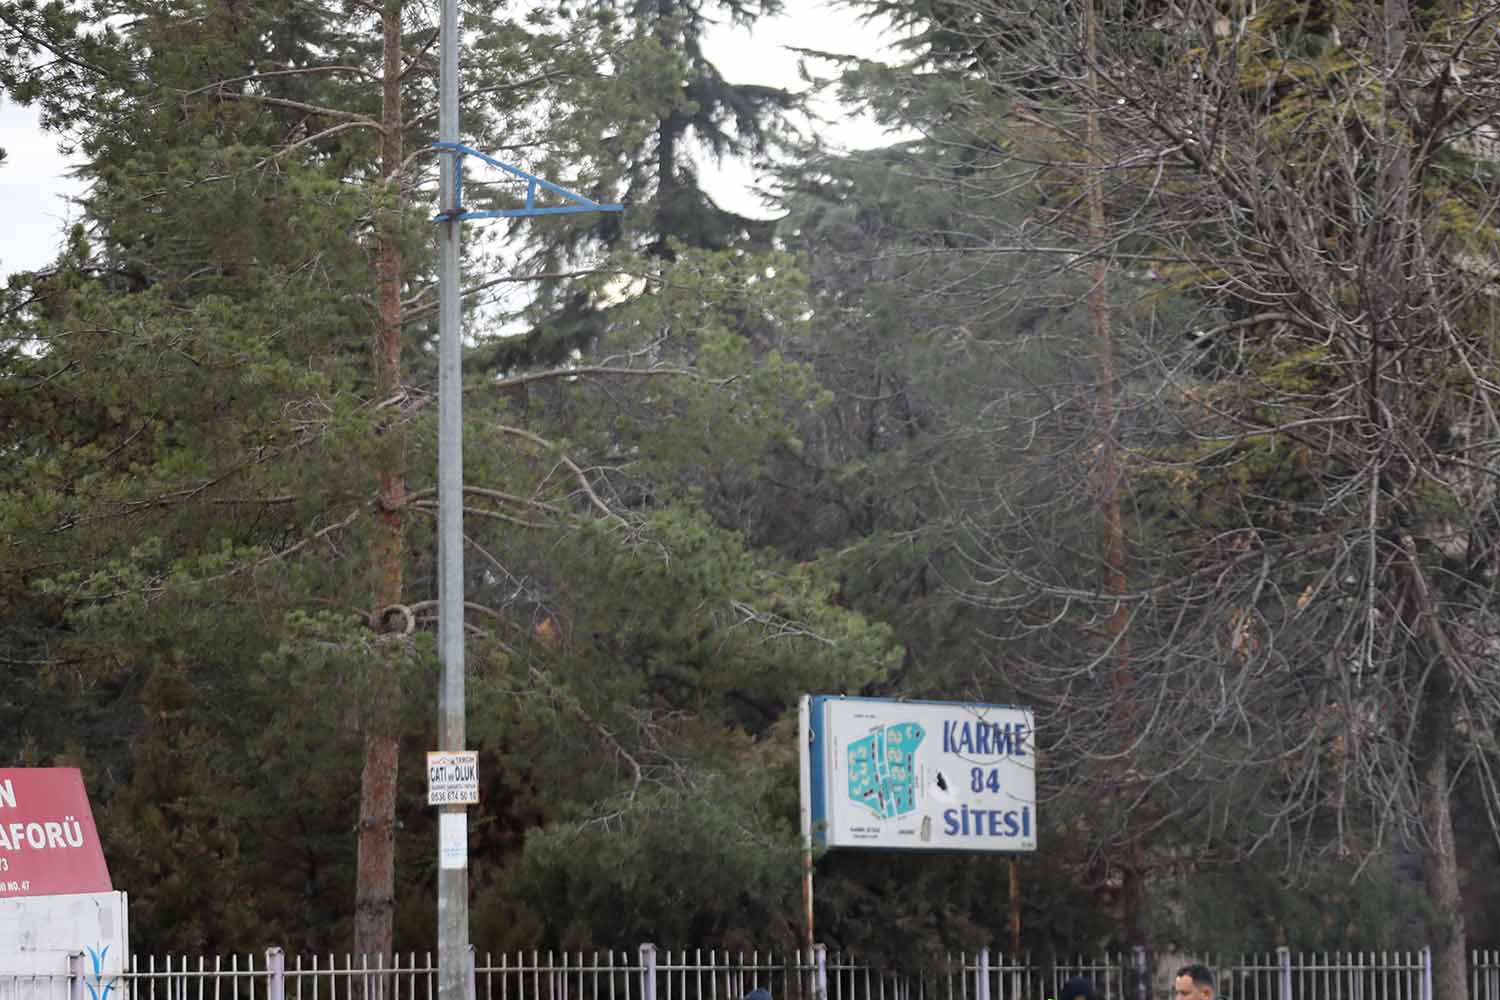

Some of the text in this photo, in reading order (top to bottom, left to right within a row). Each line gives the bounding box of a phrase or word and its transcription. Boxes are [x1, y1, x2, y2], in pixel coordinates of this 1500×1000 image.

[943, 719, 1026, 756] KARME
[455, 765, 475, 781] OLUK
[970, 766, 1000, 794] 84
[943, 803, 1031, 837] SİTESİ
